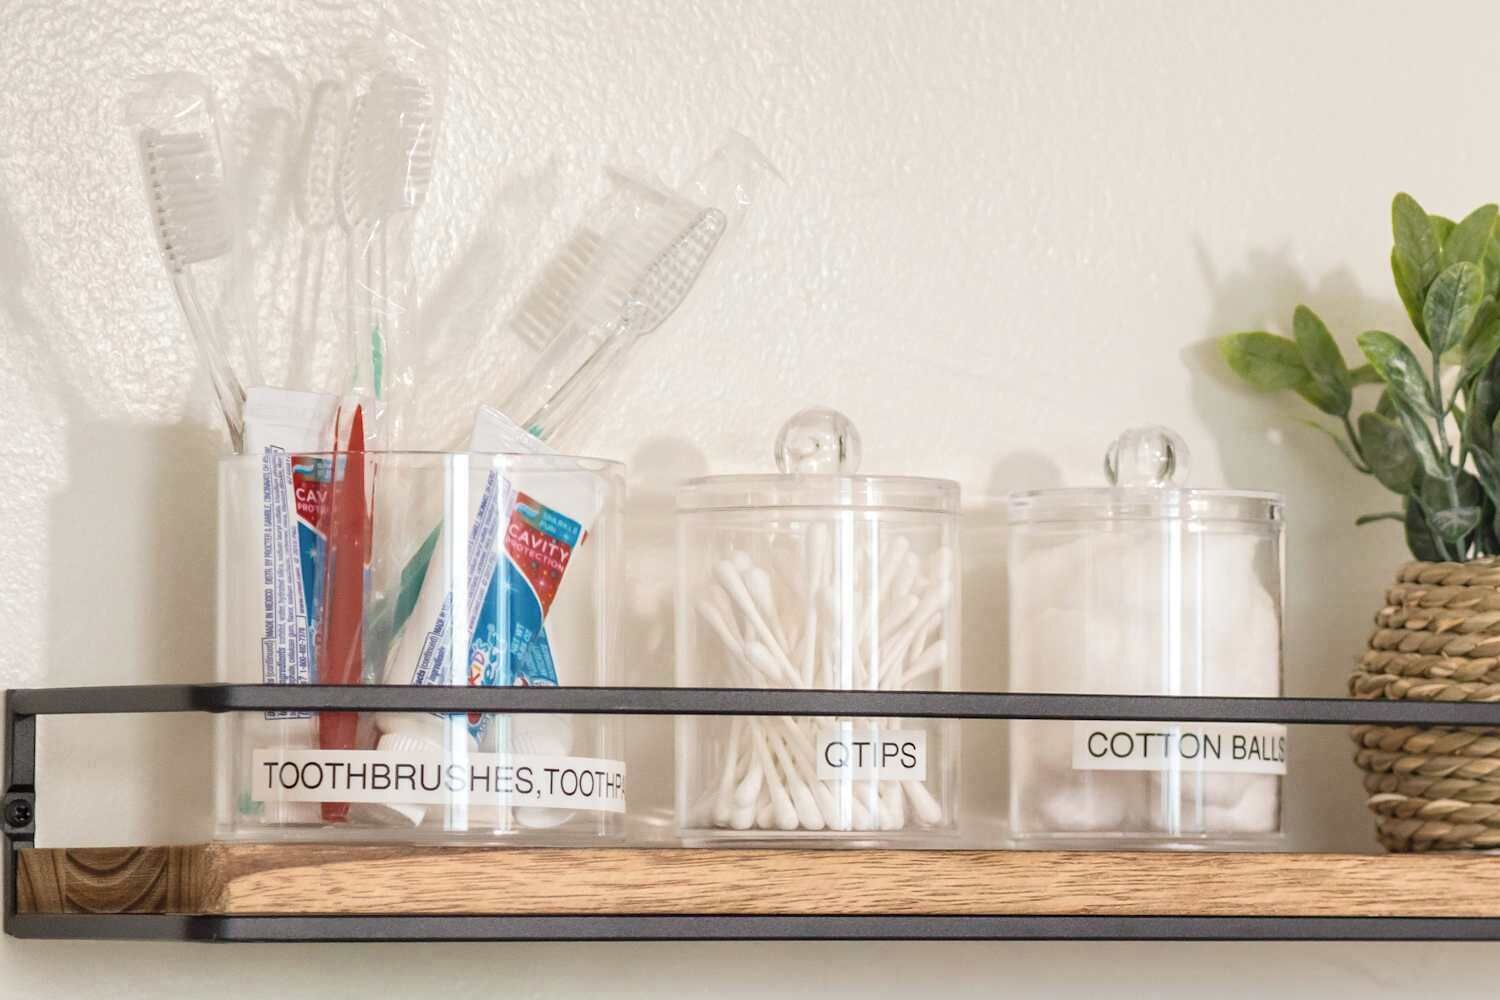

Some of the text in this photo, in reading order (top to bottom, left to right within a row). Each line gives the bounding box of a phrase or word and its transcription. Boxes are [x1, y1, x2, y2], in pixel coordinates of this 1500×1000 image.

[508, 523, 570, 563] CAVITY
[1087, 731, 1285, 763] COTTON BALLS
